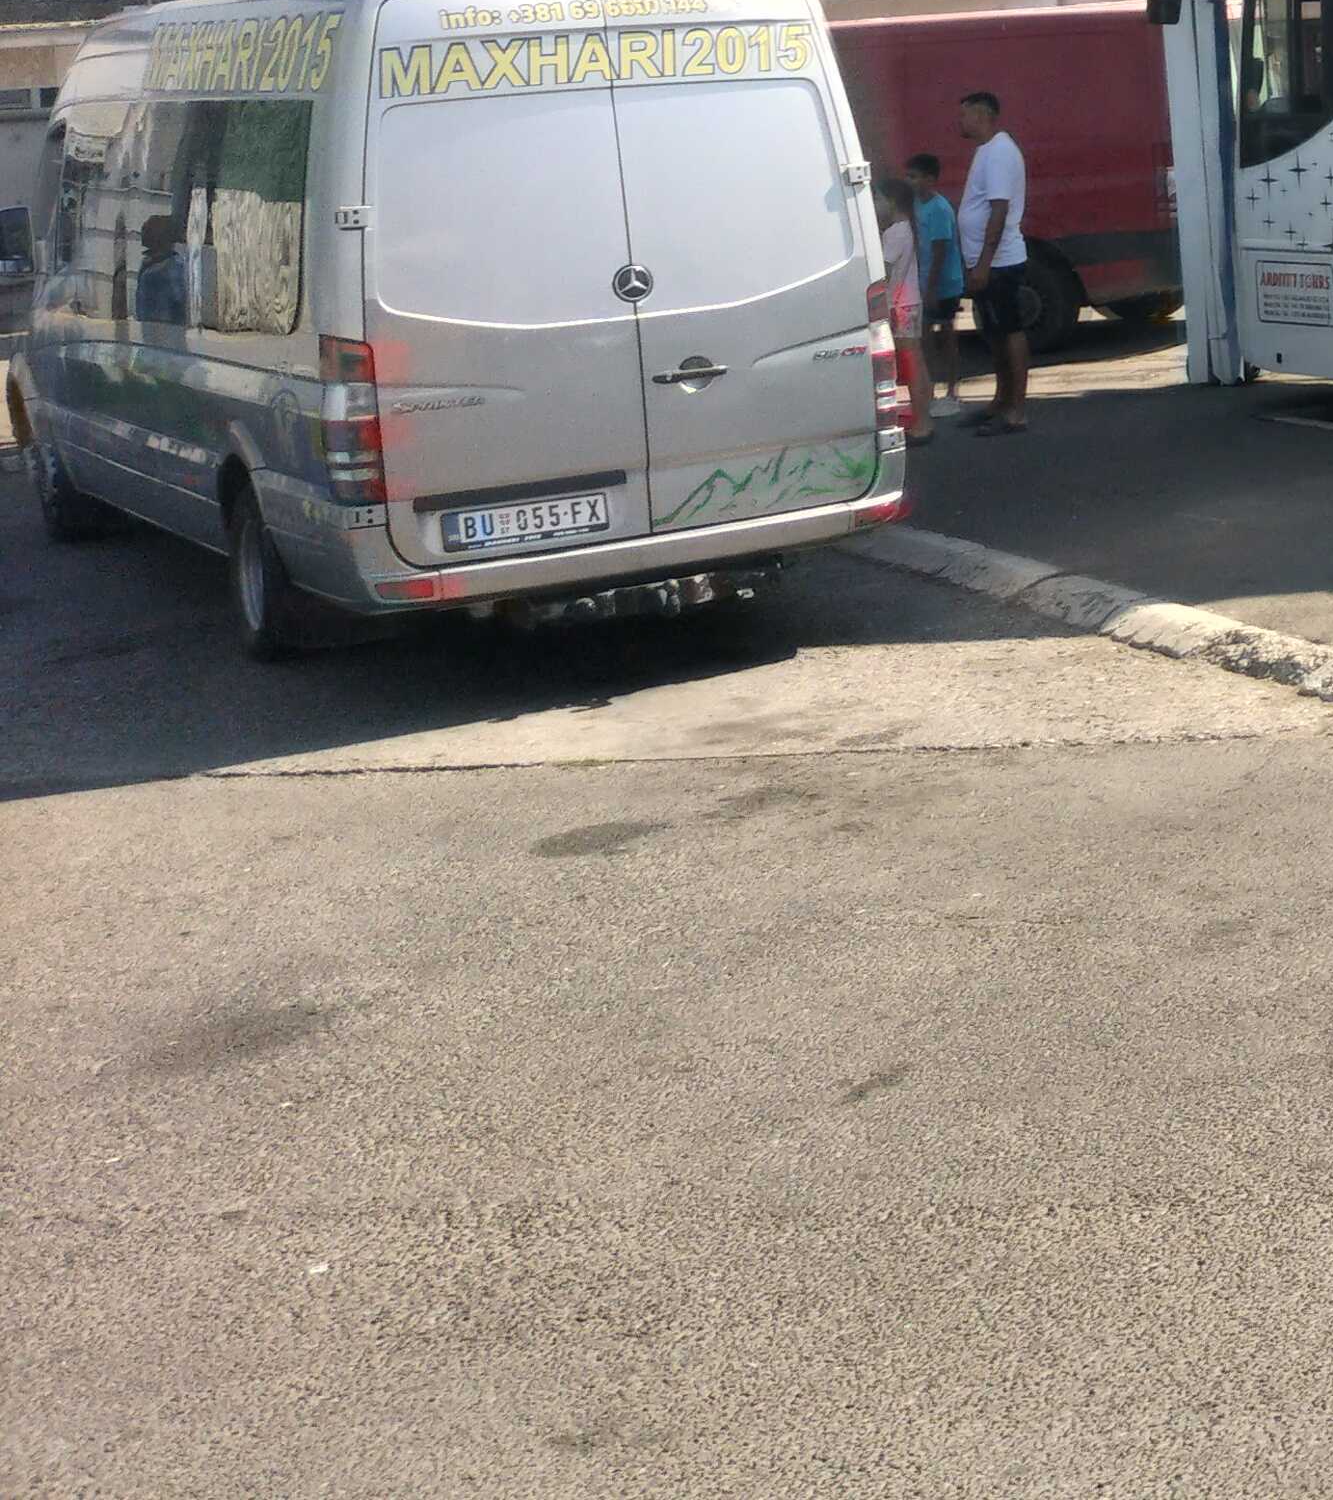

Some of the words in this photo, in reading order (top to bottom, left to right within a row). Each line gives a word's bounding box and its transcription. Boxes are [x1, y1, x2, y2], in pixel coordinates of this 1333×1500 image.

[438, 5, 501, 31] info:
[508, 2, 564, 24] +381
[463, 514, 494, 539] BU
